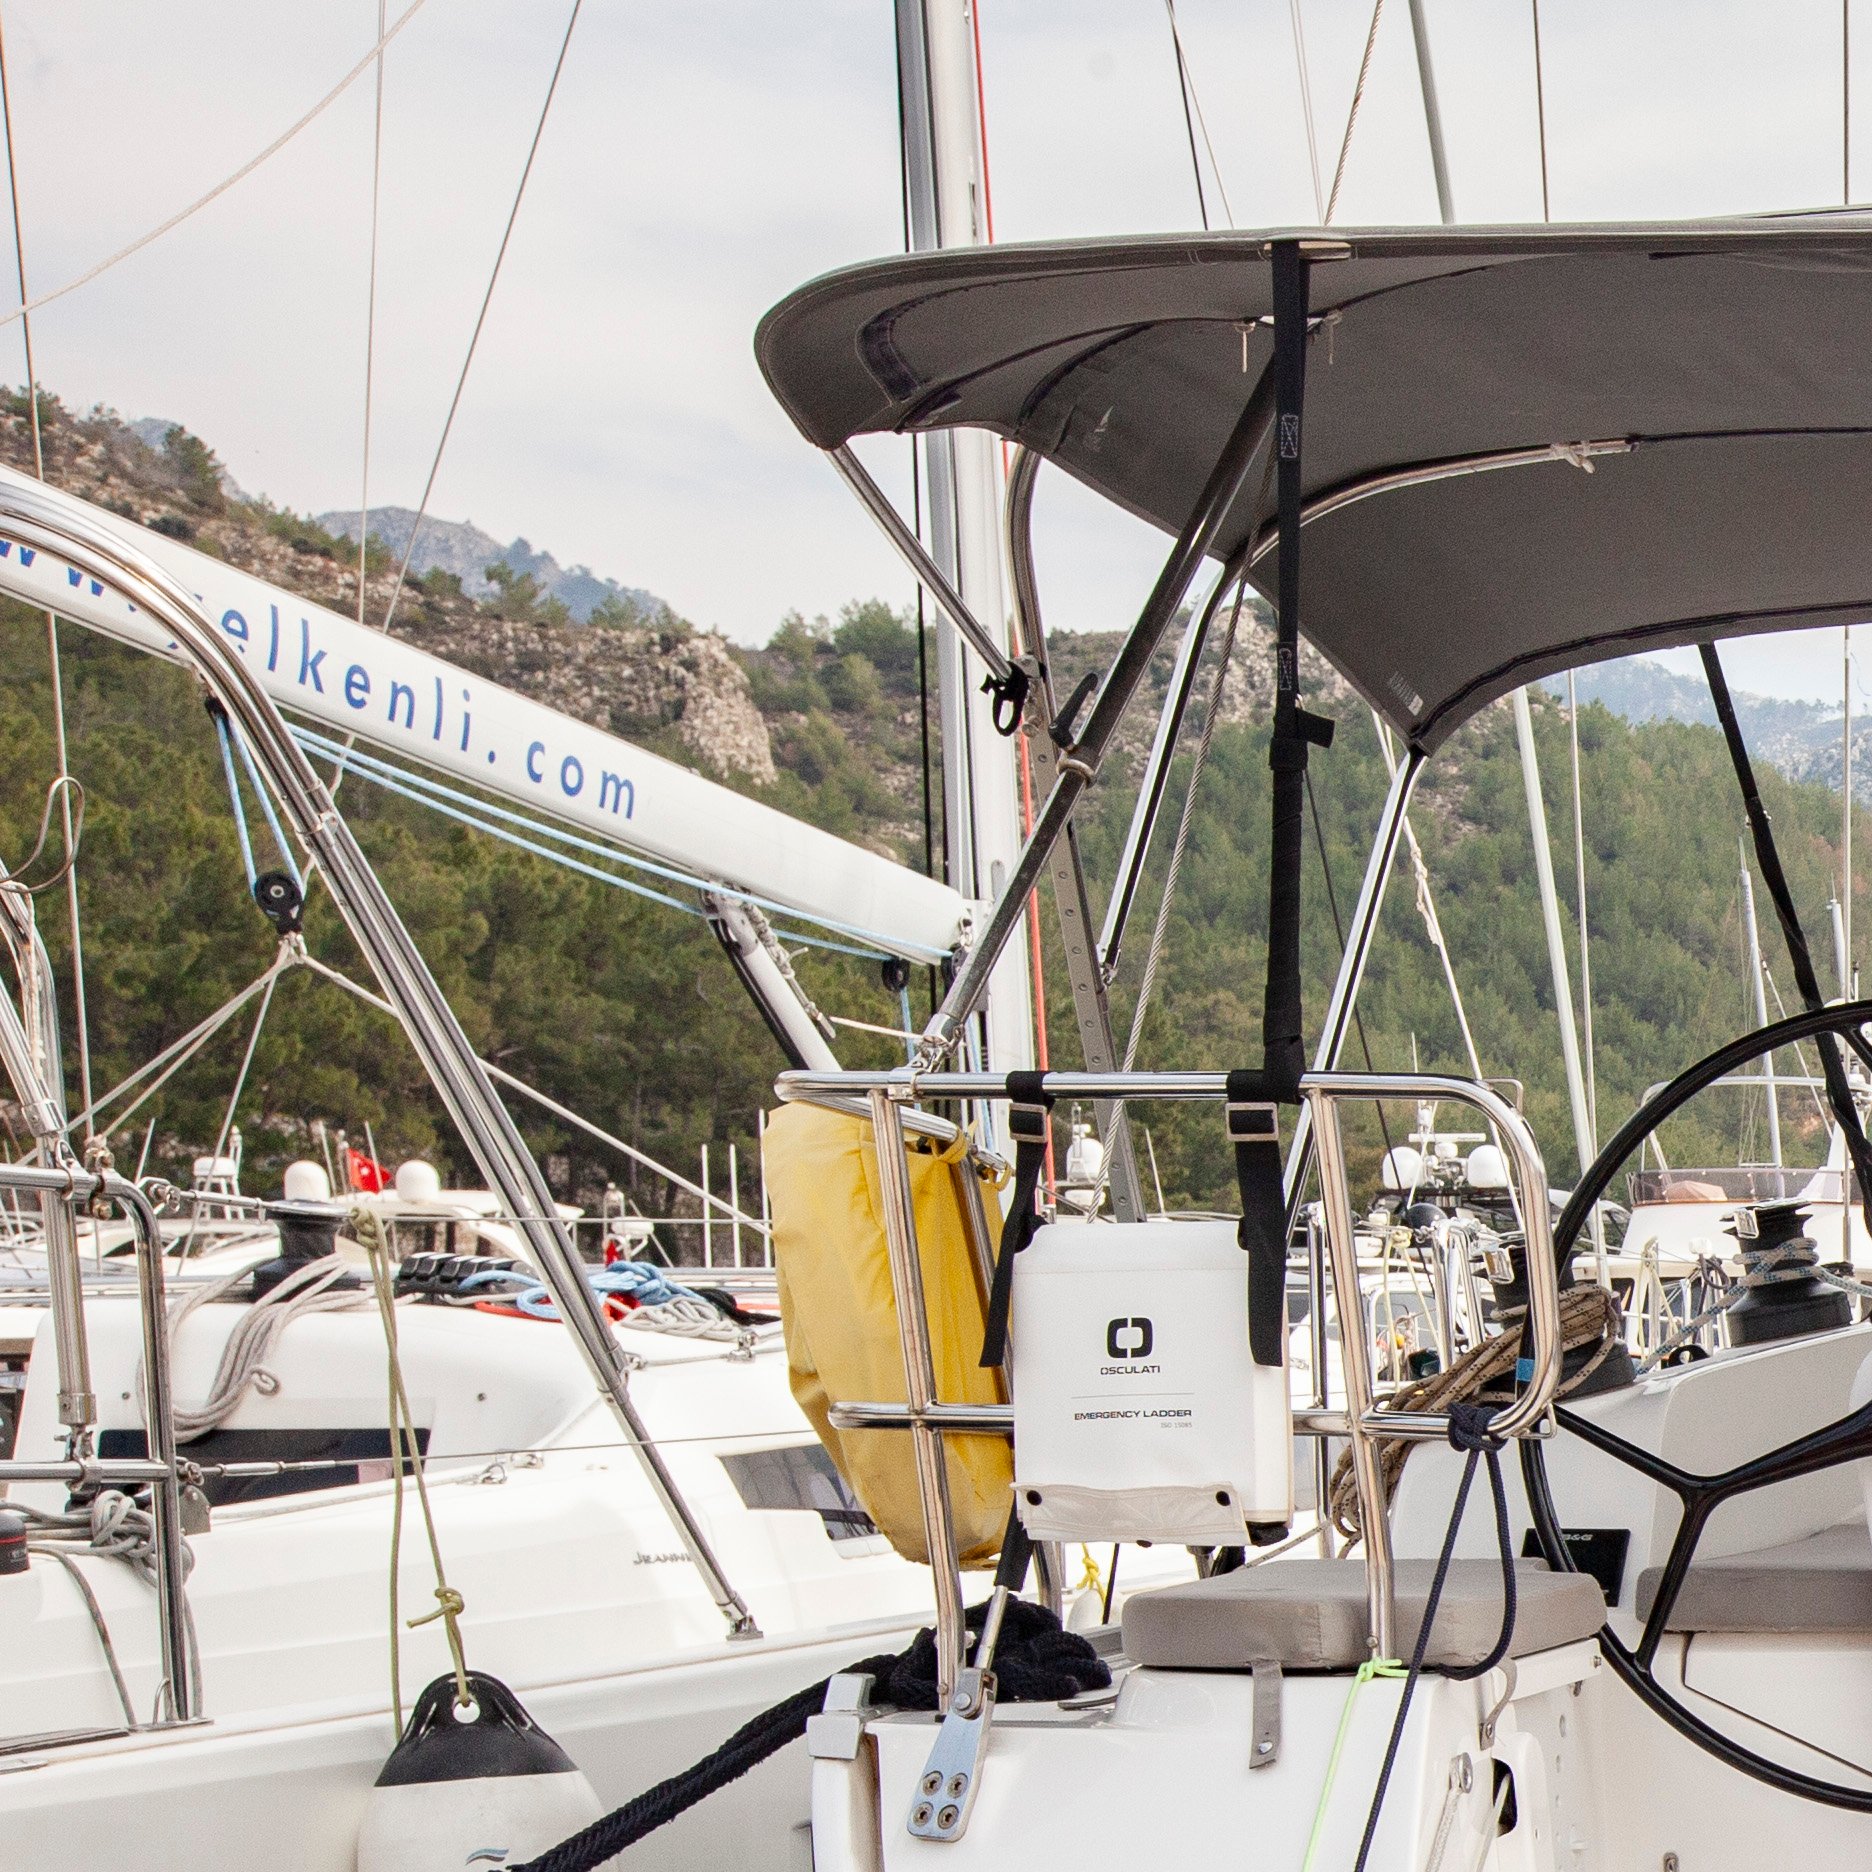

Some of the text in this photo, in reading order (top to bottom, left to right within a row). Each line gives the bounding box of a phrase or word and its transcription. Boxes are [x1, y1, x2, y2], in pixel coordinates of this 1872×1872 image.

[1100, 1365, 1161, 1376] OSCULATI
[1074, 1409, 1192, 1421] EMERGENCY LADDER
